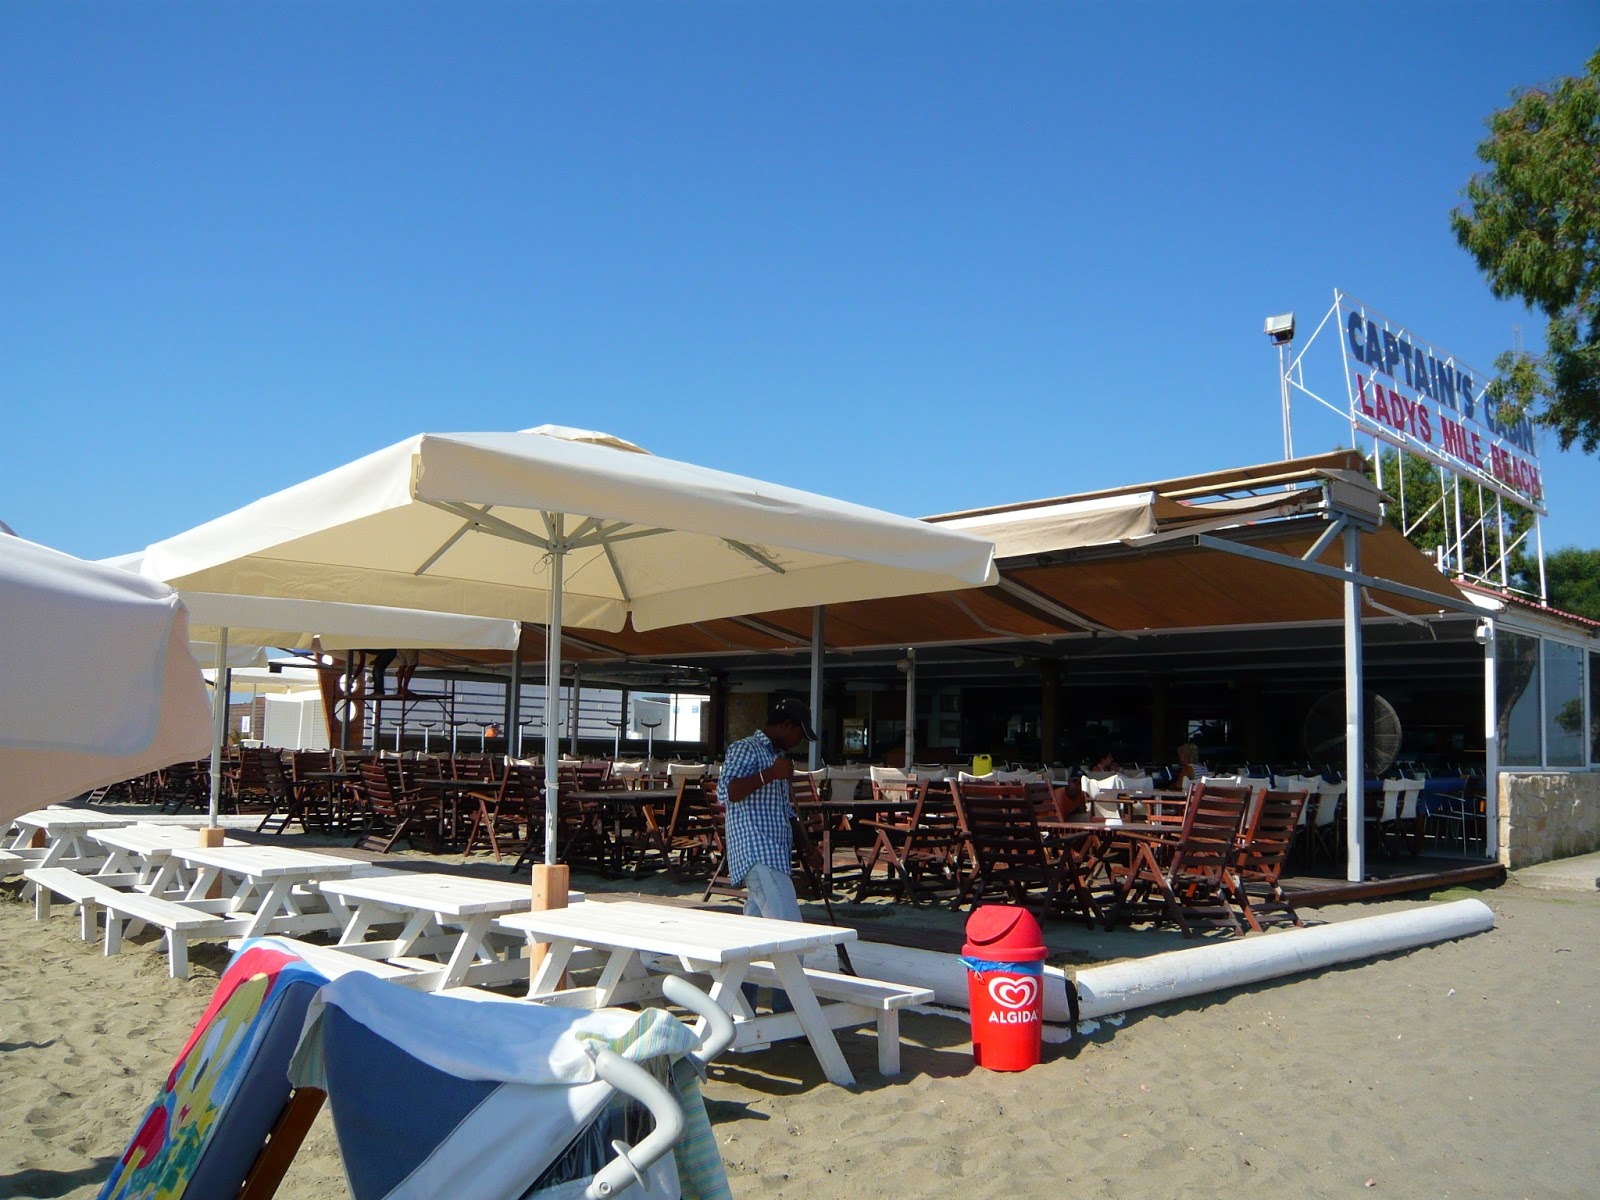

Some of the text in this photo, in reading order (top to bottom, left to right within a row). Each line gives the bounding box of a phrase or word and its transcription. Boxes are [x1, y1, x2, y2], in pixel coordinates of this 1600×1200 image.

[1348, 311, 1475, 419] CAPTAIN'S
[1357, 373, 1539, 498] LADYS MILE BEACH
[988, 1010, 1038, 1024] ALGIDA
